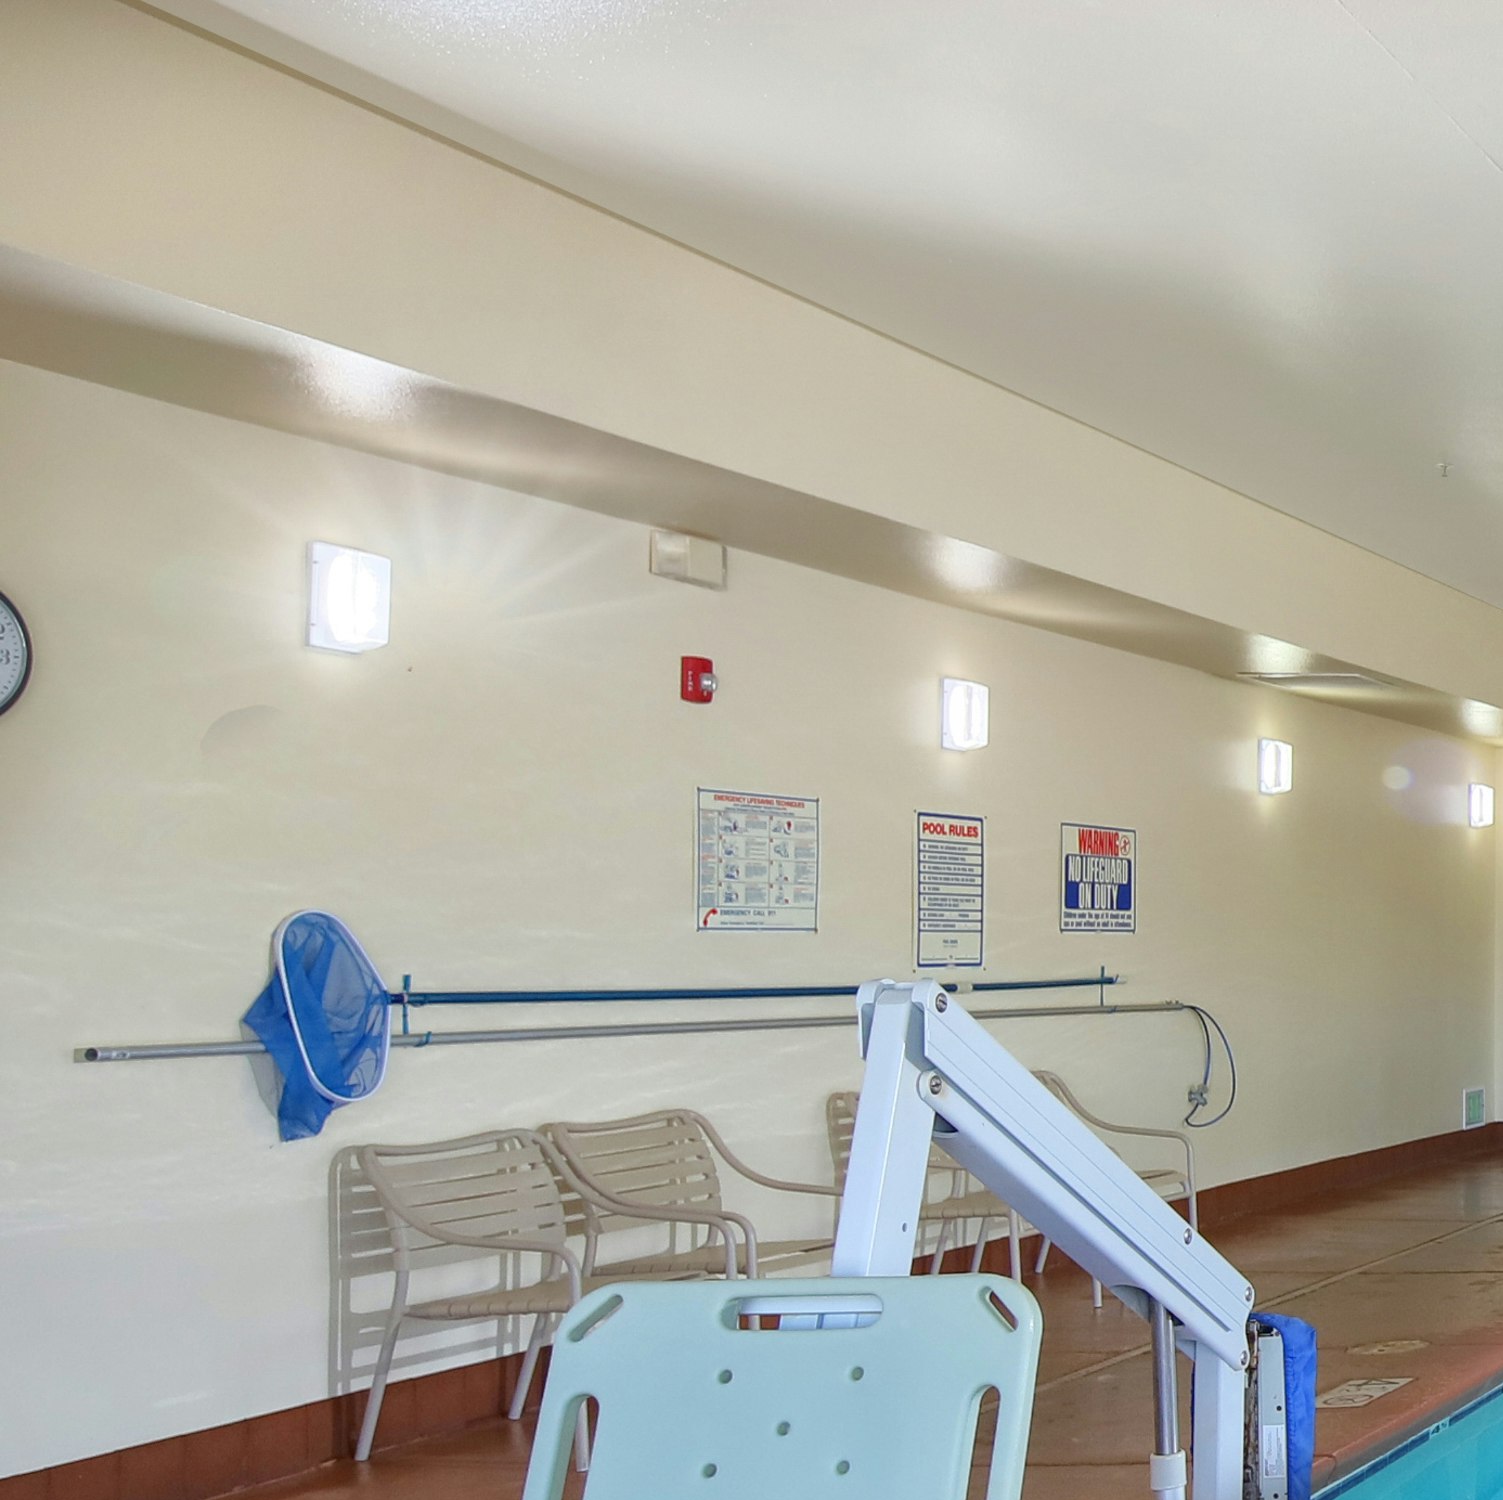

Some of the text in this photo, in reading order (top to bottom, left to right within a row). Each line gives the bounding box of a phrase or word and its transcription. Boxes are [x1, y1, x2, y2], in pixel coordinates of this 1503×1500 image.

[713, 794, 805, 809] EMERGENCY LIFESAVING TECHNIQUES
[922, 822, 979, 838] POOL RULES
[1078, 828, 1120, 857] WARNING
[1068, 855, 1129, 885] NO LIFEGUARD
[1079, 882, 1119, 910] ON DUTY
[720, 909, 751, 917] EMERGENCY
